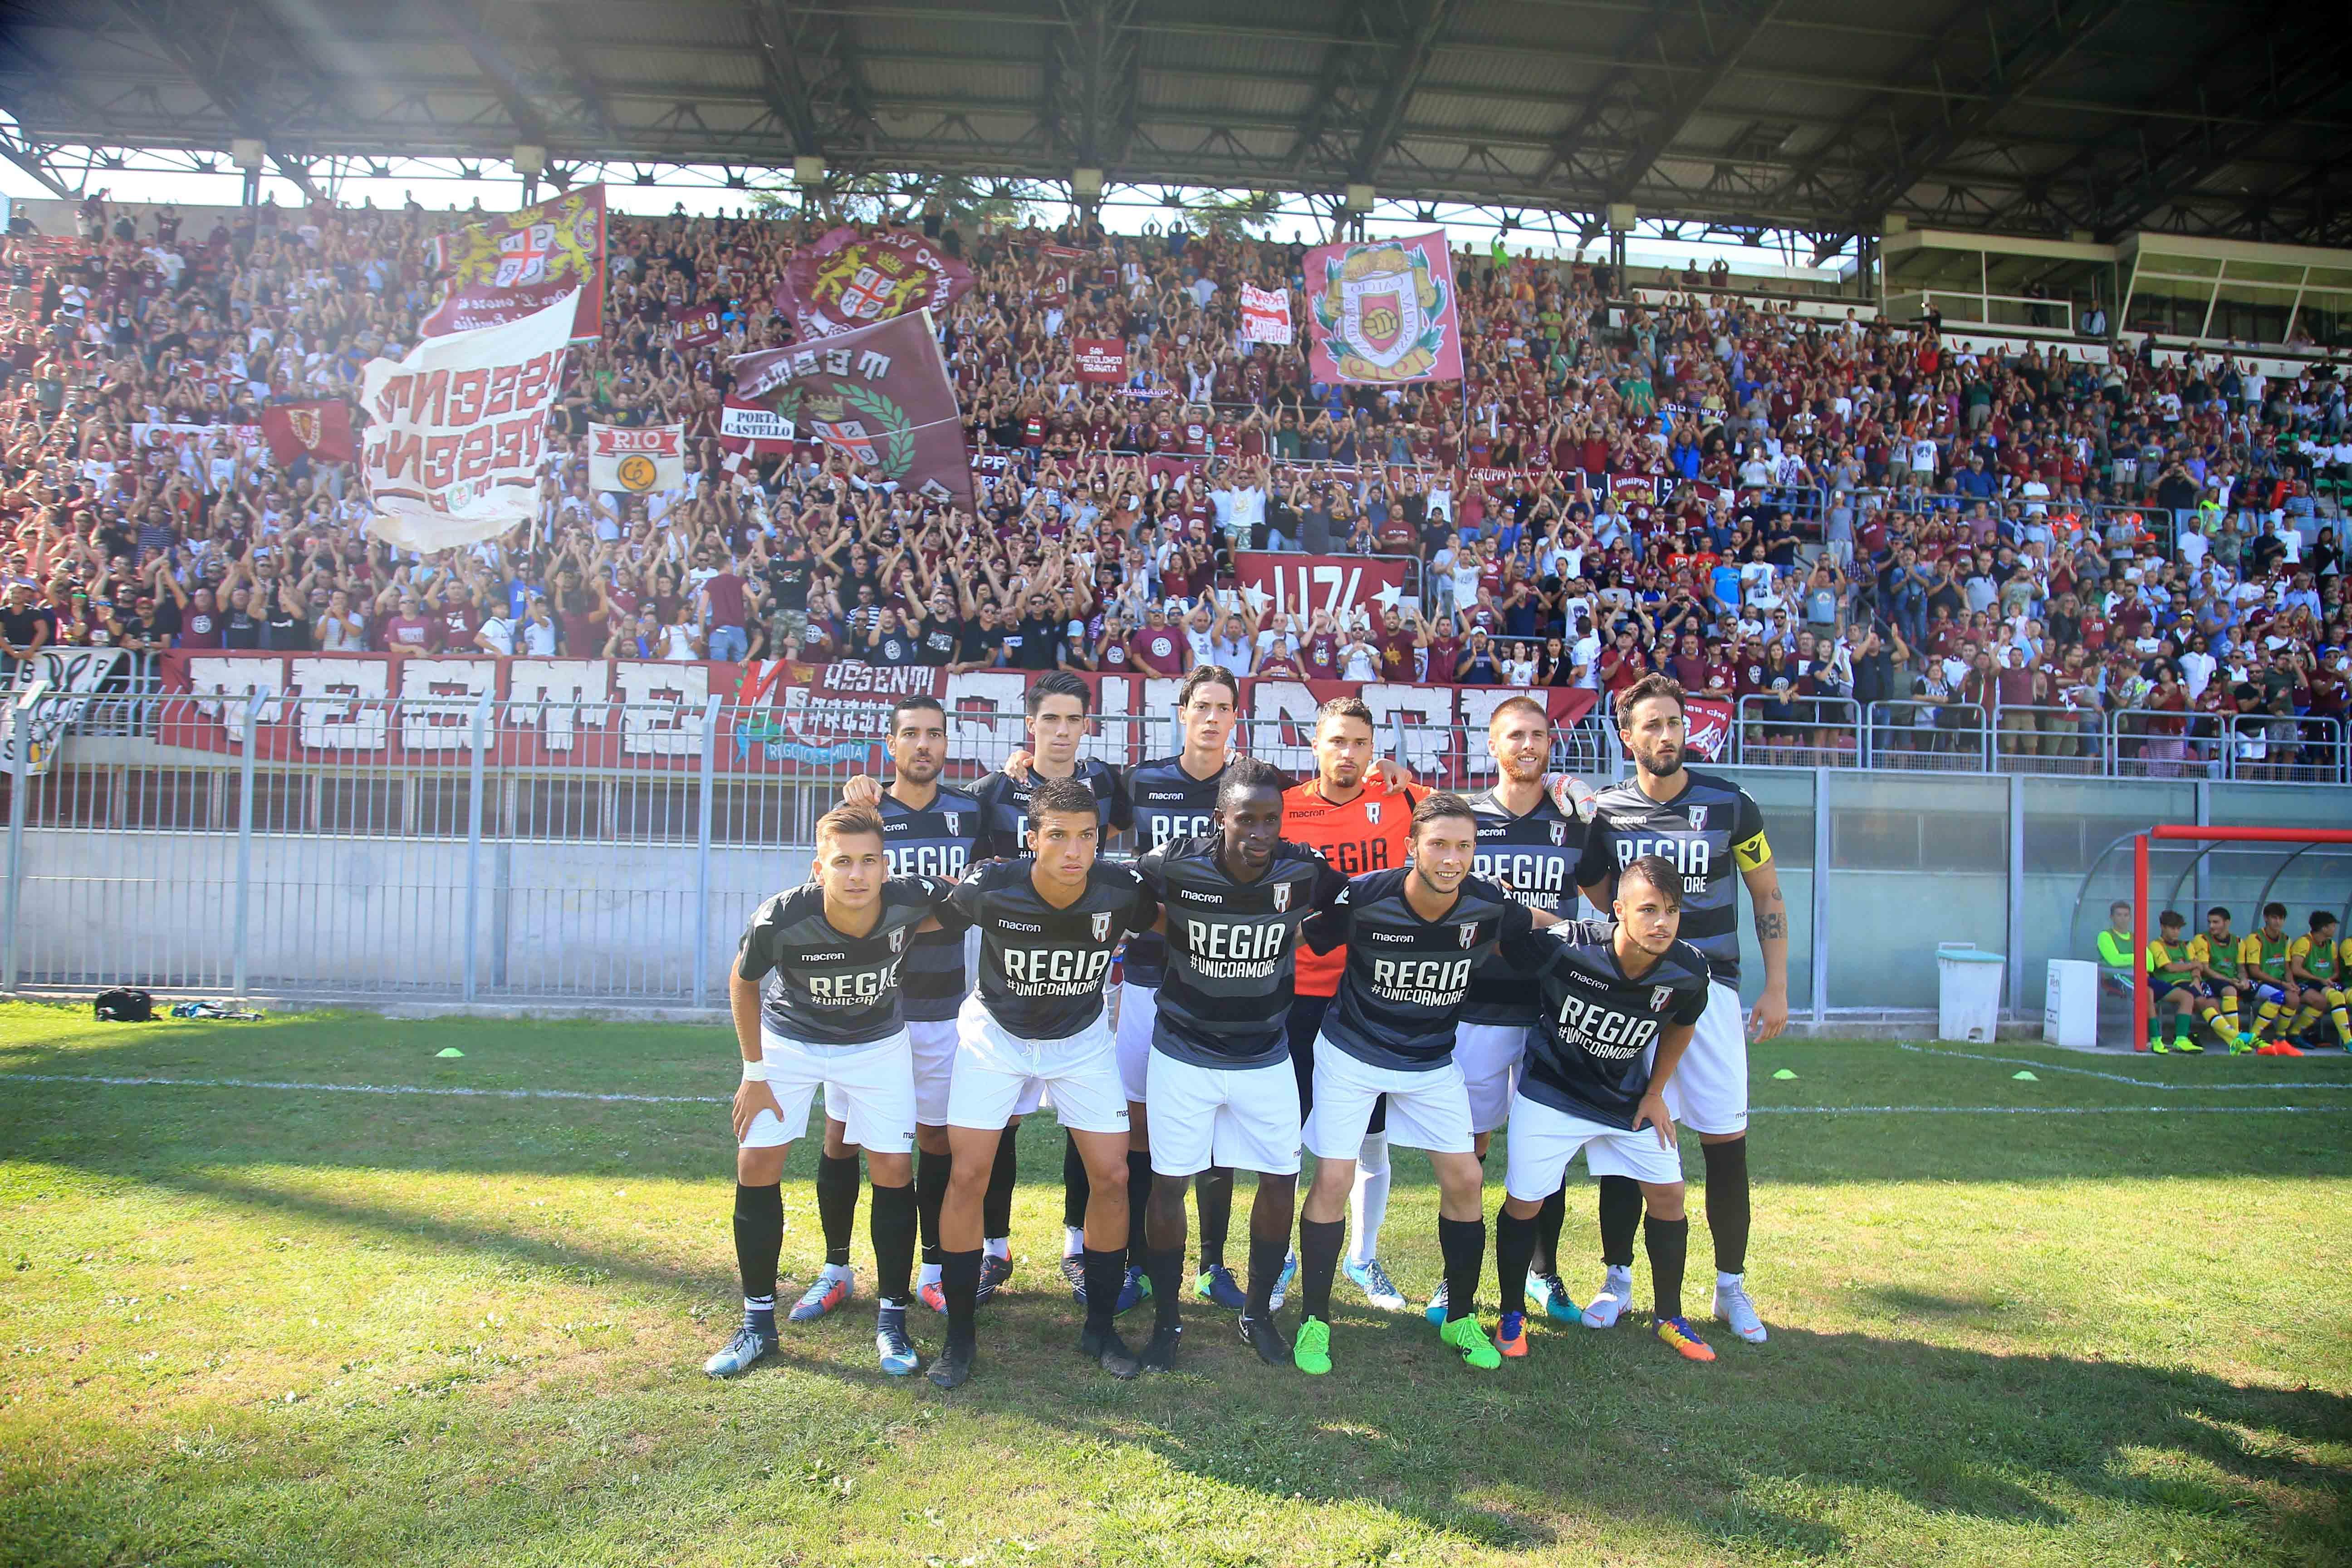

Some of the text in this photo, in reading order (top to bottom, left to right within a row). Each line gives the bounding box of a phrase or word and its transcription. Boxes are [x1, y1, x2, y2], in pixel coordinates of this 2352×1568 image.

[737, 412, 780, 425] PORTA
[725, 422, 790, 436] CASTELLO
[612, 431, 661, 448] RIO
[1013, 792, 1032, 802] mac
[1148, 791, 1184, 801] macron
[1289, 808, 1325, 818] macron
[1610, 814, 1646, 825] macron
[1319, 837, 1388, 874] EGIA
[1181, 889, 1223, 904] macron
[998, 919, 1042, 933] macron
[1187, 919, 1286, 960] REGIA
[1372, 932, 1414, 943] macron
[802, 952, 845, 961] macron
[1004, 947, 1111, 983] REGIA
[1374, 958, 1472, 991] REGIA
[1570, 971, 1609, 991] macron
[1558, 994, 1658, 1046] REGIA
